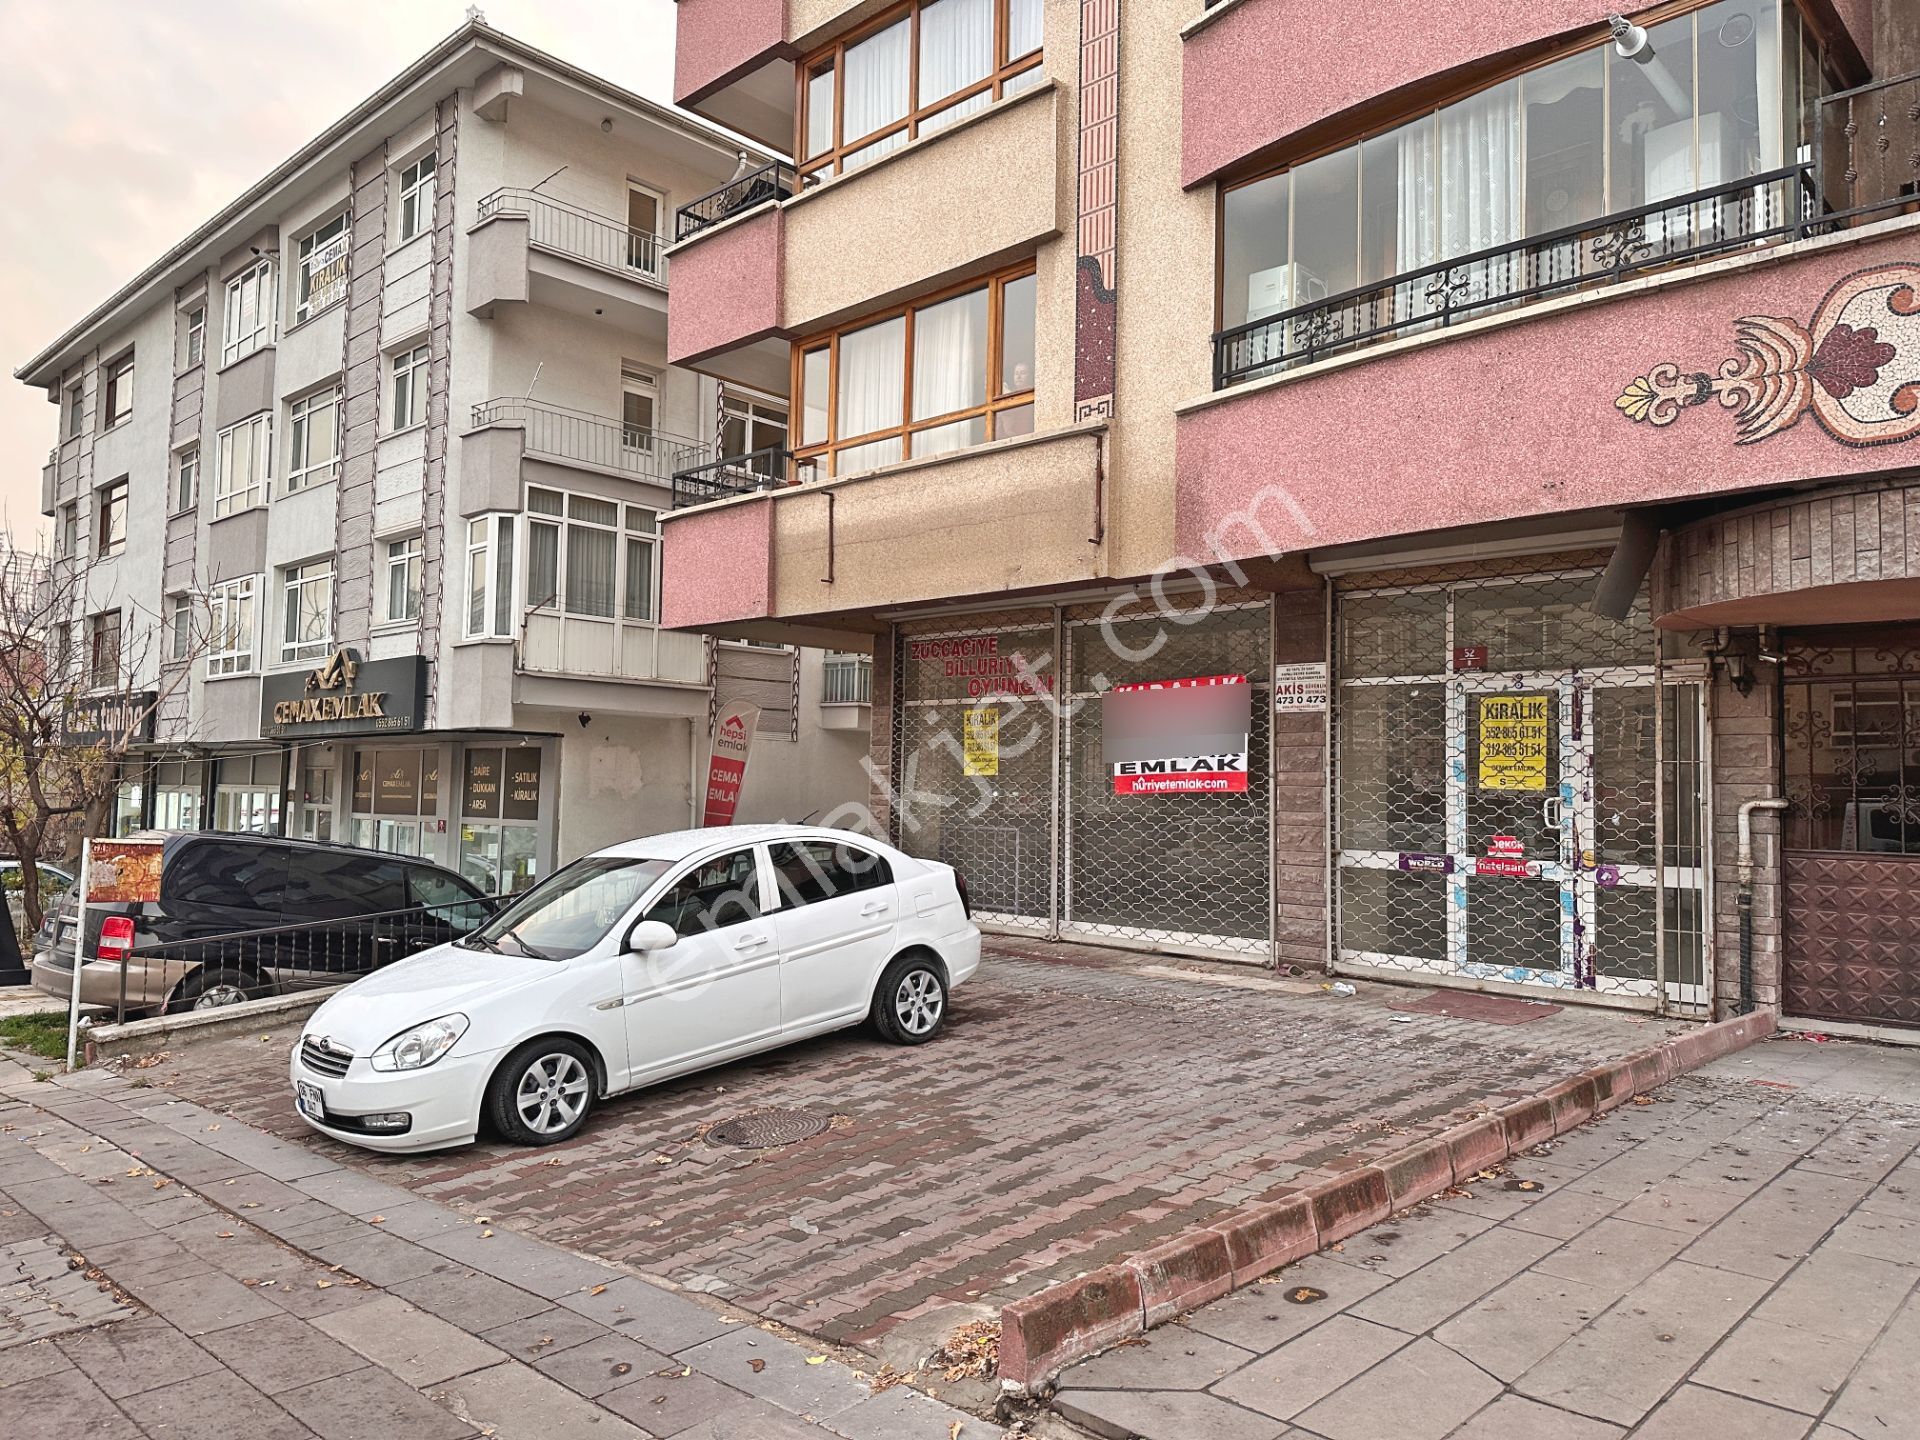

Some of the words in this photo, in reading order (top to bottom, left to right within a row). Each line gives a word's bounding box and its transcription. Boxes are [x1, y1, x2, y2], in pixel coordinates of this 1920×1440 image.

[1297, 696, 1303, 704] 0
[1306, 695, 1326, 703] 473
[720, 726, 747, 741] hepsi
[718, 739, 747, 751] emlak
[1120, 758, 1240, 775] EMLAK
[514, 772, 537, 783] SATILIK
[708, 788, 737, 803] EMLA
[472, 799, 487, 809] ARSA
